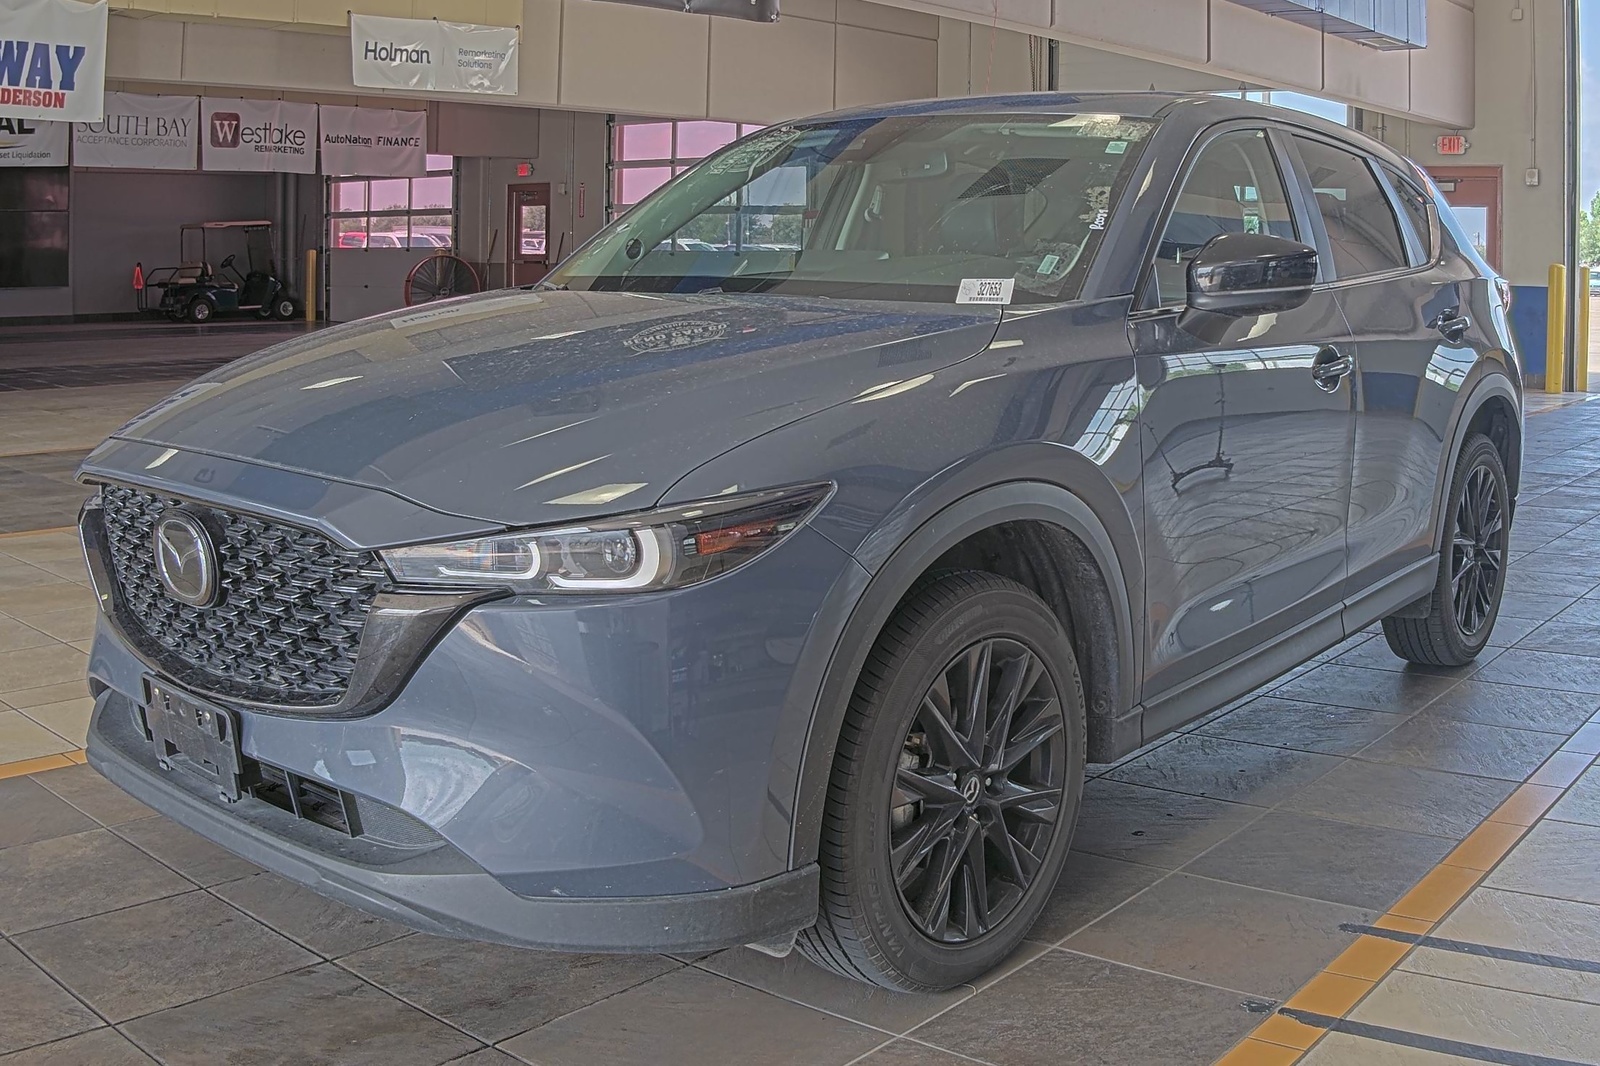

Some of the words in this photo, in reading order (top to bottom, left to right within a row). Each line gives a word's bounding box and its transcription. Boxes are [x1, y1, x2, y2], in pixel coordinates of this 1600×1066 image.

[364, 41, 432, 65] Holman
[458, 48, 507, 61] Remarketing
[0, 40, 86, 91] WAY
[457, 59, 493, 70] Solutions
[0, 88, 66, 109] DERSON
[77, 114, 149, 136] SOUTH
[157, 117, 192, 137] BAY
[213, 120, 306, 147] Westlake
[324, 133, 373, 145] AutoNation
[376, 136, 421, 147] FINANCE
[77, 135, 129, 146] ACCEPTANCE
[131, 137, 188, 148] CORPORATION
[1441, 137, 1461, 153] EXIT
[12, 151, 51, 160] Liquidation
[254, 145, 305, 155] REMARKETING
[977, 281, 1002, 296] 327653
